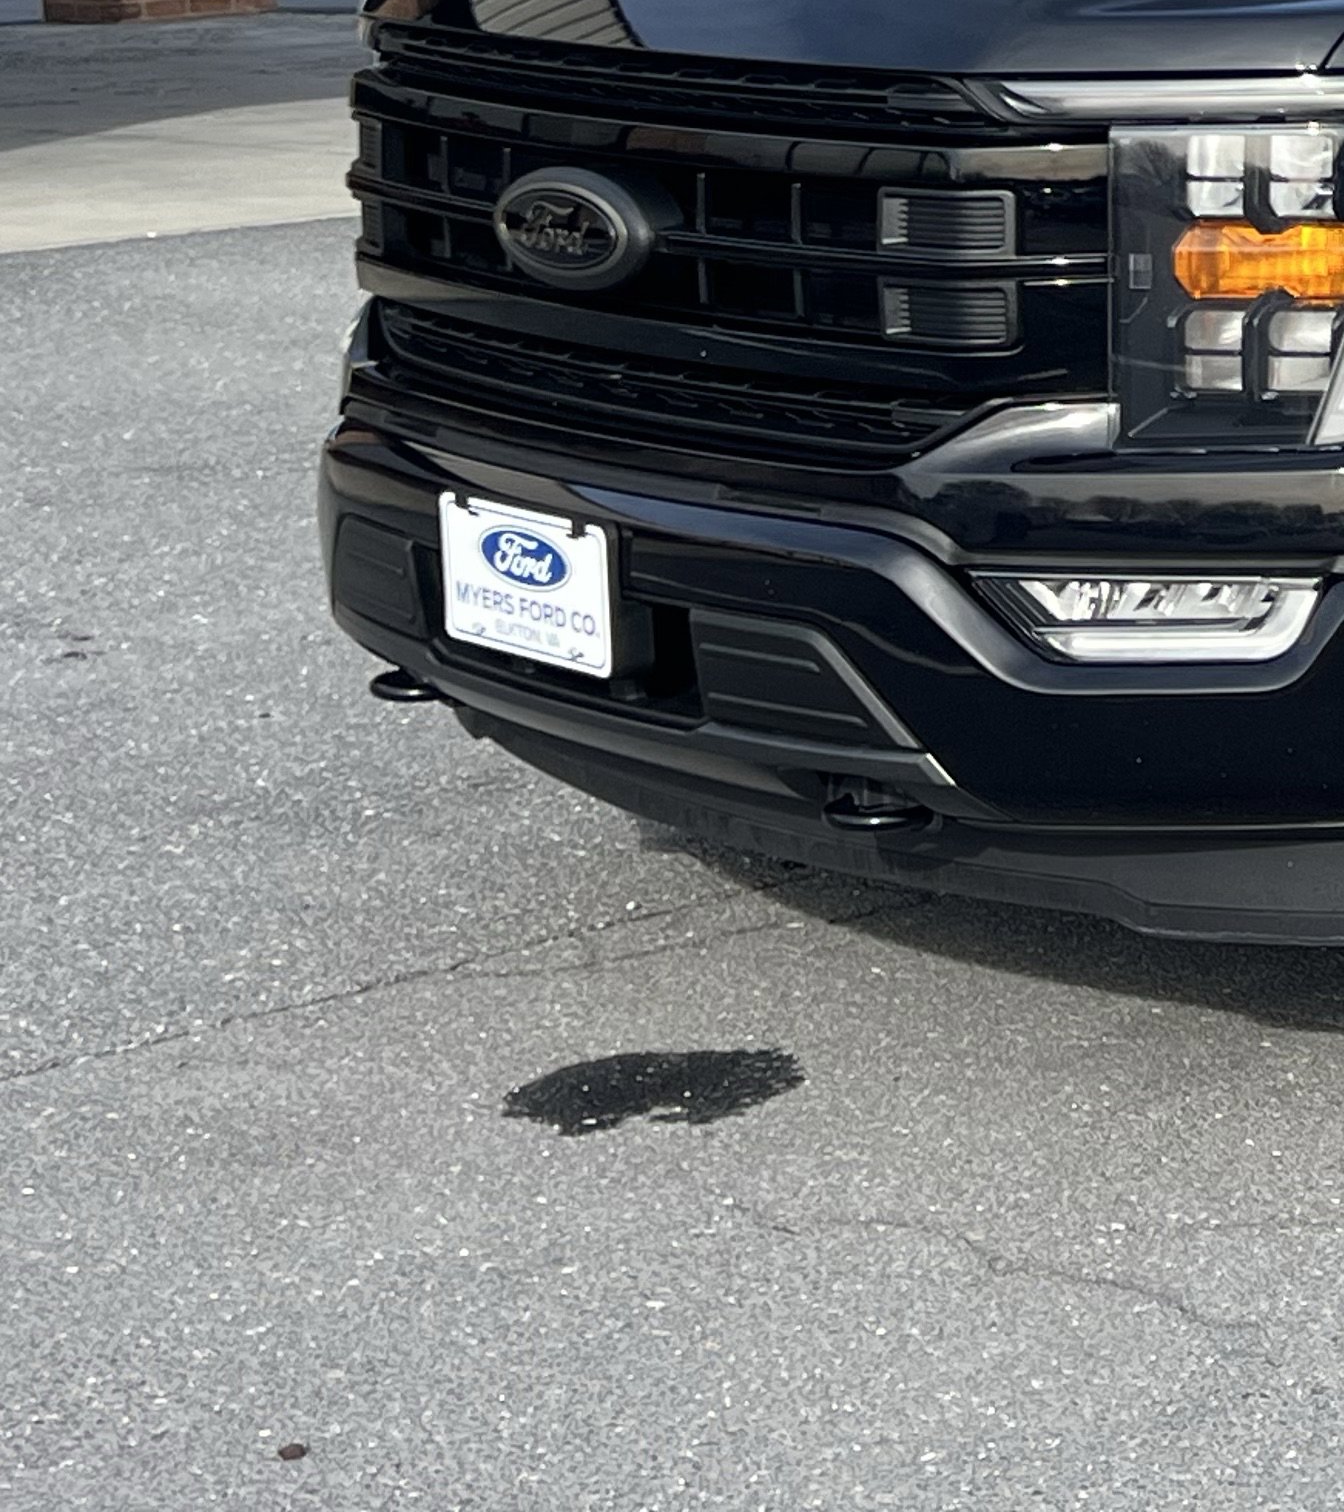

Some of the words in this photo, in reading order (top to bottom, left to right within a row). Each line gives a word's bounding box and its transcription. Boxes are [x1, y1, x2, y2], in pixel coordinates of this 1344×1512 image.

[514, 200, 590, 256] Ford
[494, 532, 553, 584] Ford
[456, 580, 515, 616] MYERS
[519, 597, 567, 629] FORD
